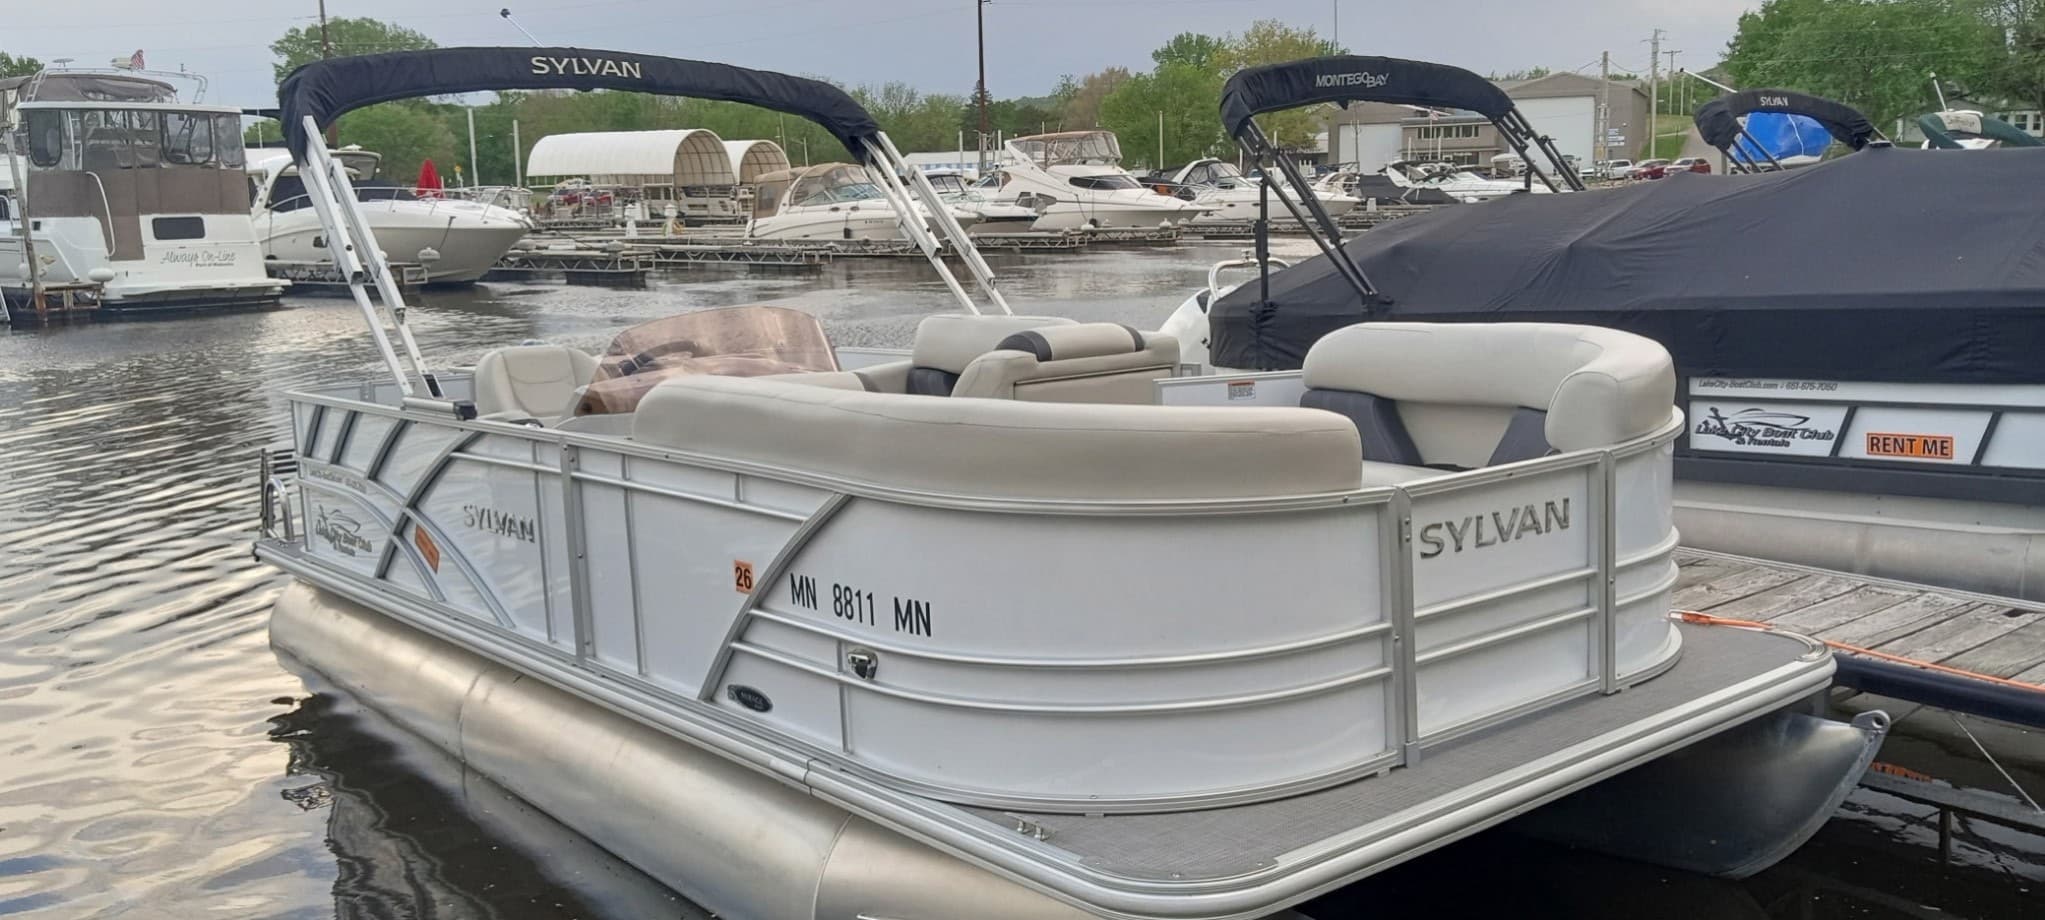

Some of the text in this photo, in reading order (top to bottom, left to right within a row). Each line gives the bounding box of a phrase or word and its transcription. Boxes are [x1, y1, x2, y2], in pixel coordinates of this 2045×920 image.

[531, 56, 642, 79] SYLVAN
[1760, 96, 1789, 106] SYLVAN
[160, 250, 200, 267] Always
[1695, 420, 1835, 441] Lake City Boat Club
[1747, 438, 1791, 448] Rentals
[1870, 436, 1950, 456] RENT ME
[463, 504, 536, 543] SYLVAN
[1420, 498, 1570, 559] SYLVAN
[735, 566, 752, 589] 26
[790, 573, 931, 637] MN 8811 MN
